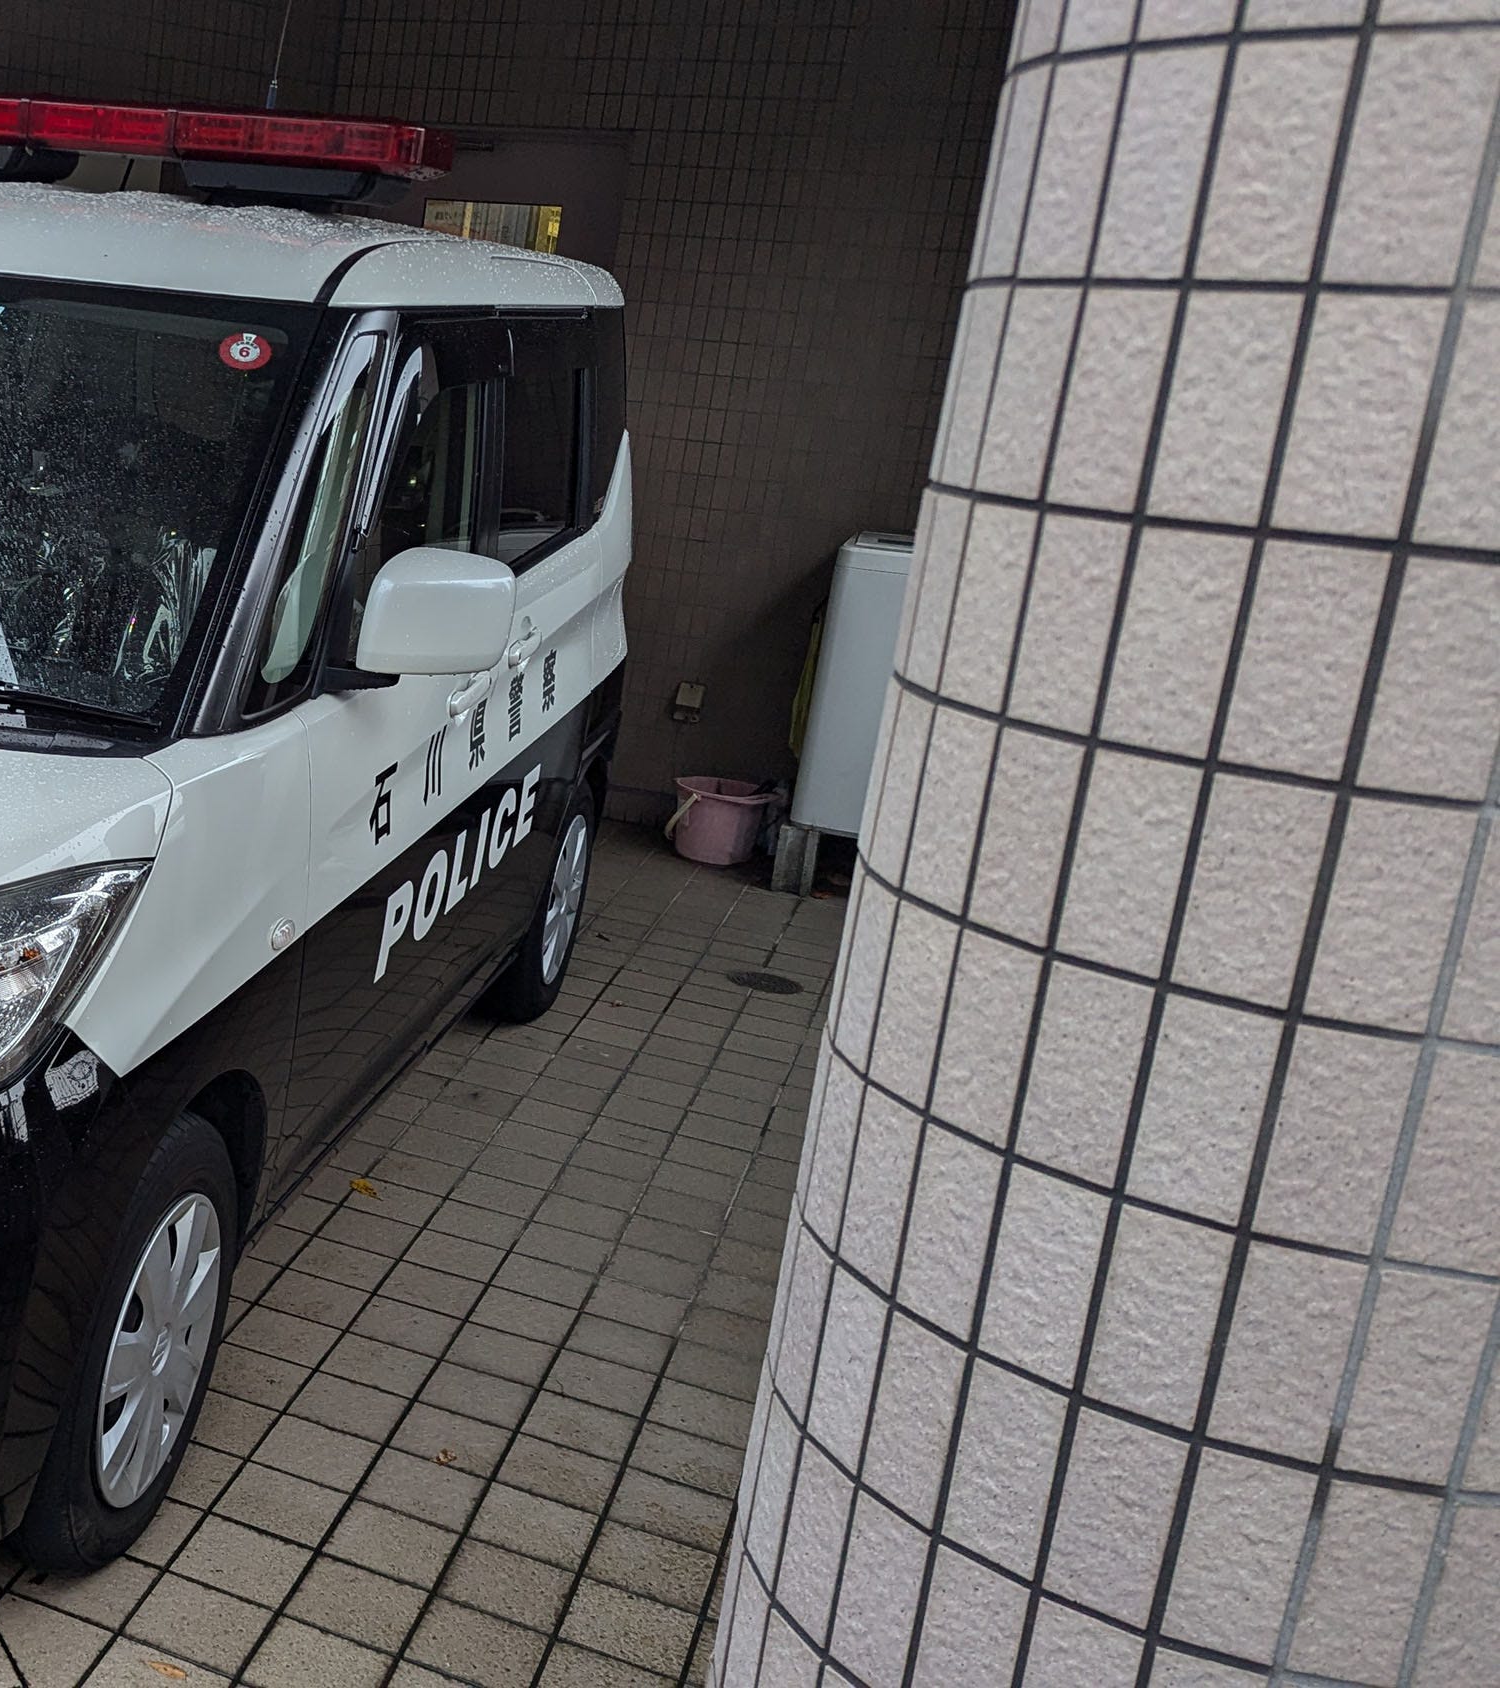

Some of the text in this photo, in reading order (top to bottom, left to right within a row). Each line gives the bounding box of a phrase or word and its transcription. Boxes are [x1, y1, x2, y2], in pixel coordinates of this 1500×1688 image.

[239, 346, 250, 357] 6
[369, 648, 557, 846] 石川県警察
[373, 763, 541, 984] POLICE
